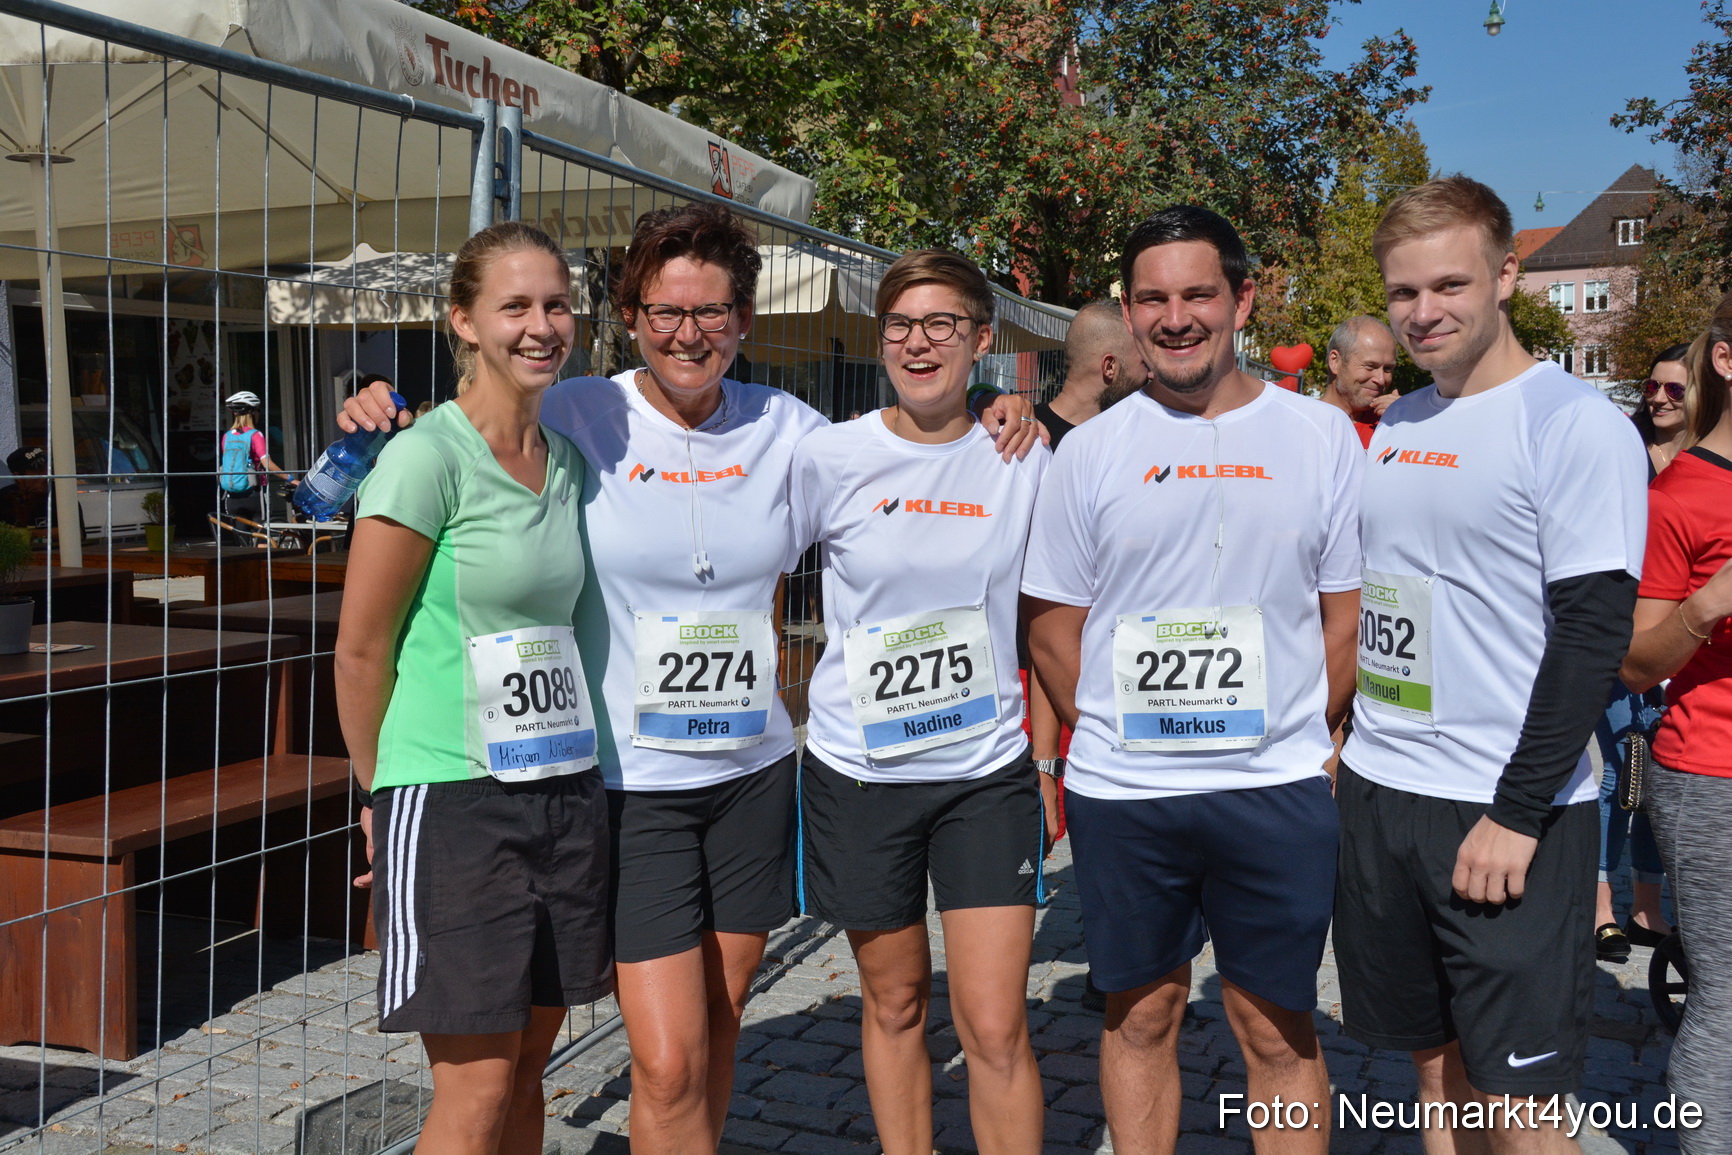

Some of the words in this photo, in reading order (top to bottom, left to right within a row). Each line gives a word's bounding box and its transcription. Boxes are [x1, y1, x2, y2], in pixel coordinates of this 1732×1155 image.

[425, 33, 539, 116] Tucher
[731, 154, 757, 181] PEPE
[1398, 450, 1459, 468] KLEBL
[661, 464, 748, 484] KLEBL
[1178, 464, 1273, 480] KLEBL
[905, 499, 992, 518] KLEBL
[1363, 581, 1398, 603] BOCK
[680, 624, 739, 639] BOCK
[884, 621, 946, 648] BOCK
[516, 639, 560, 658] BOCK
[658, 650, 757, 692] 2274
[870, 643, 973, 701] 2275
[1136, 647, 1244, 691] 2272
[1372, 659, 1400, 674] Neumarkt
[503, 666, 578, 717] 3089
[1363, 674, 1400, 702] Manuel
[668, 700, 698, 708] PARTL
[699, 699, 739, 708] Neumarkt
[887, 703, 917, 714] PARTL
[918, 692, 959, 708] Neumarkt
[1148, 699, 1177, 707] PARTL
[1179, 697, 1224, 706] Neumarkt
[515, 721, 546, 733] PARTL
[547, 719, 574, 729] Neumarkt
[687, 718, 730, 736] Petra
[903, 712, 963, 737] Nadine
[1159, 717, 1226, 735] Markus
[499, 743, 540, 772] Mirjam
